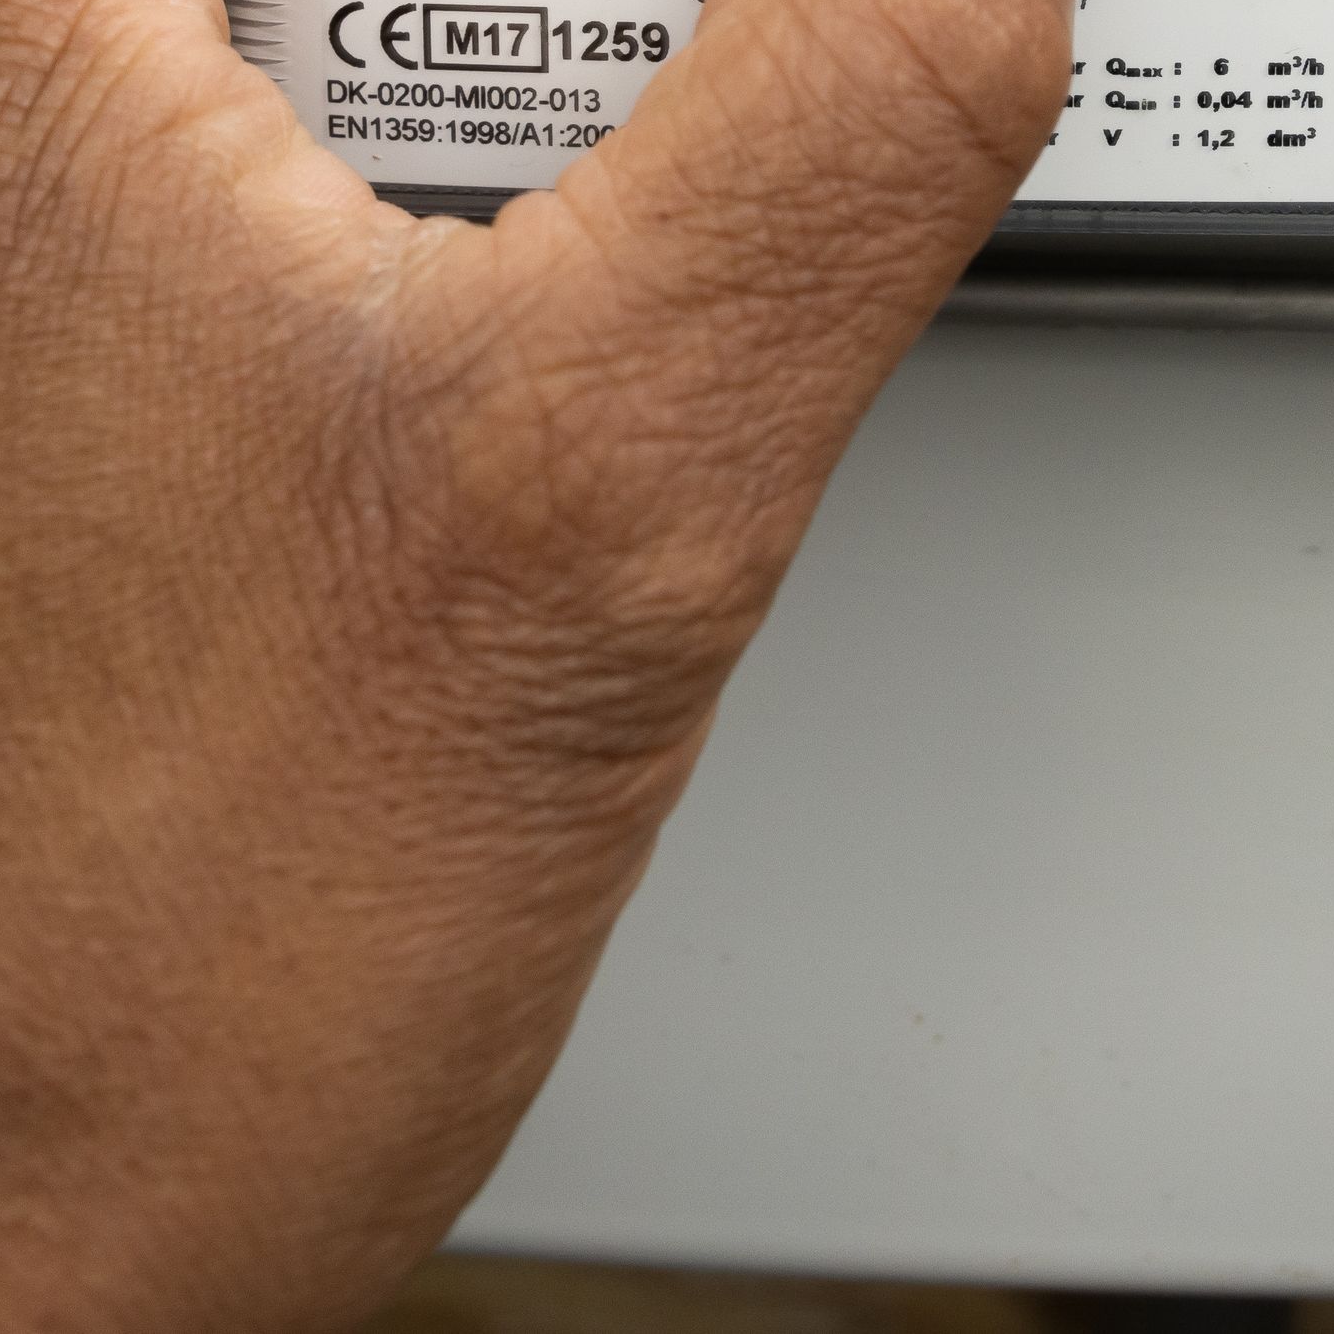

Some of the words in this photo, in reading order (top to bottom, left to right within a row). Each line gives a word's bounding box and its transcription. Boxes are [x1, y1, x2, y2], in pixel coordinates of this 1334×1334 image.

[445, 21, 530, 57] M17
[552, 20, 670, 63] 1259
[1213, 57, 1230, 76] 6
[326, 79, 601, 113] DK-0200-MI002-013
[1196, 90, 1253, 113] 0,04
[1102, 128, 1123, 147] V
[1197, 129, 1236, 152] 1,2
